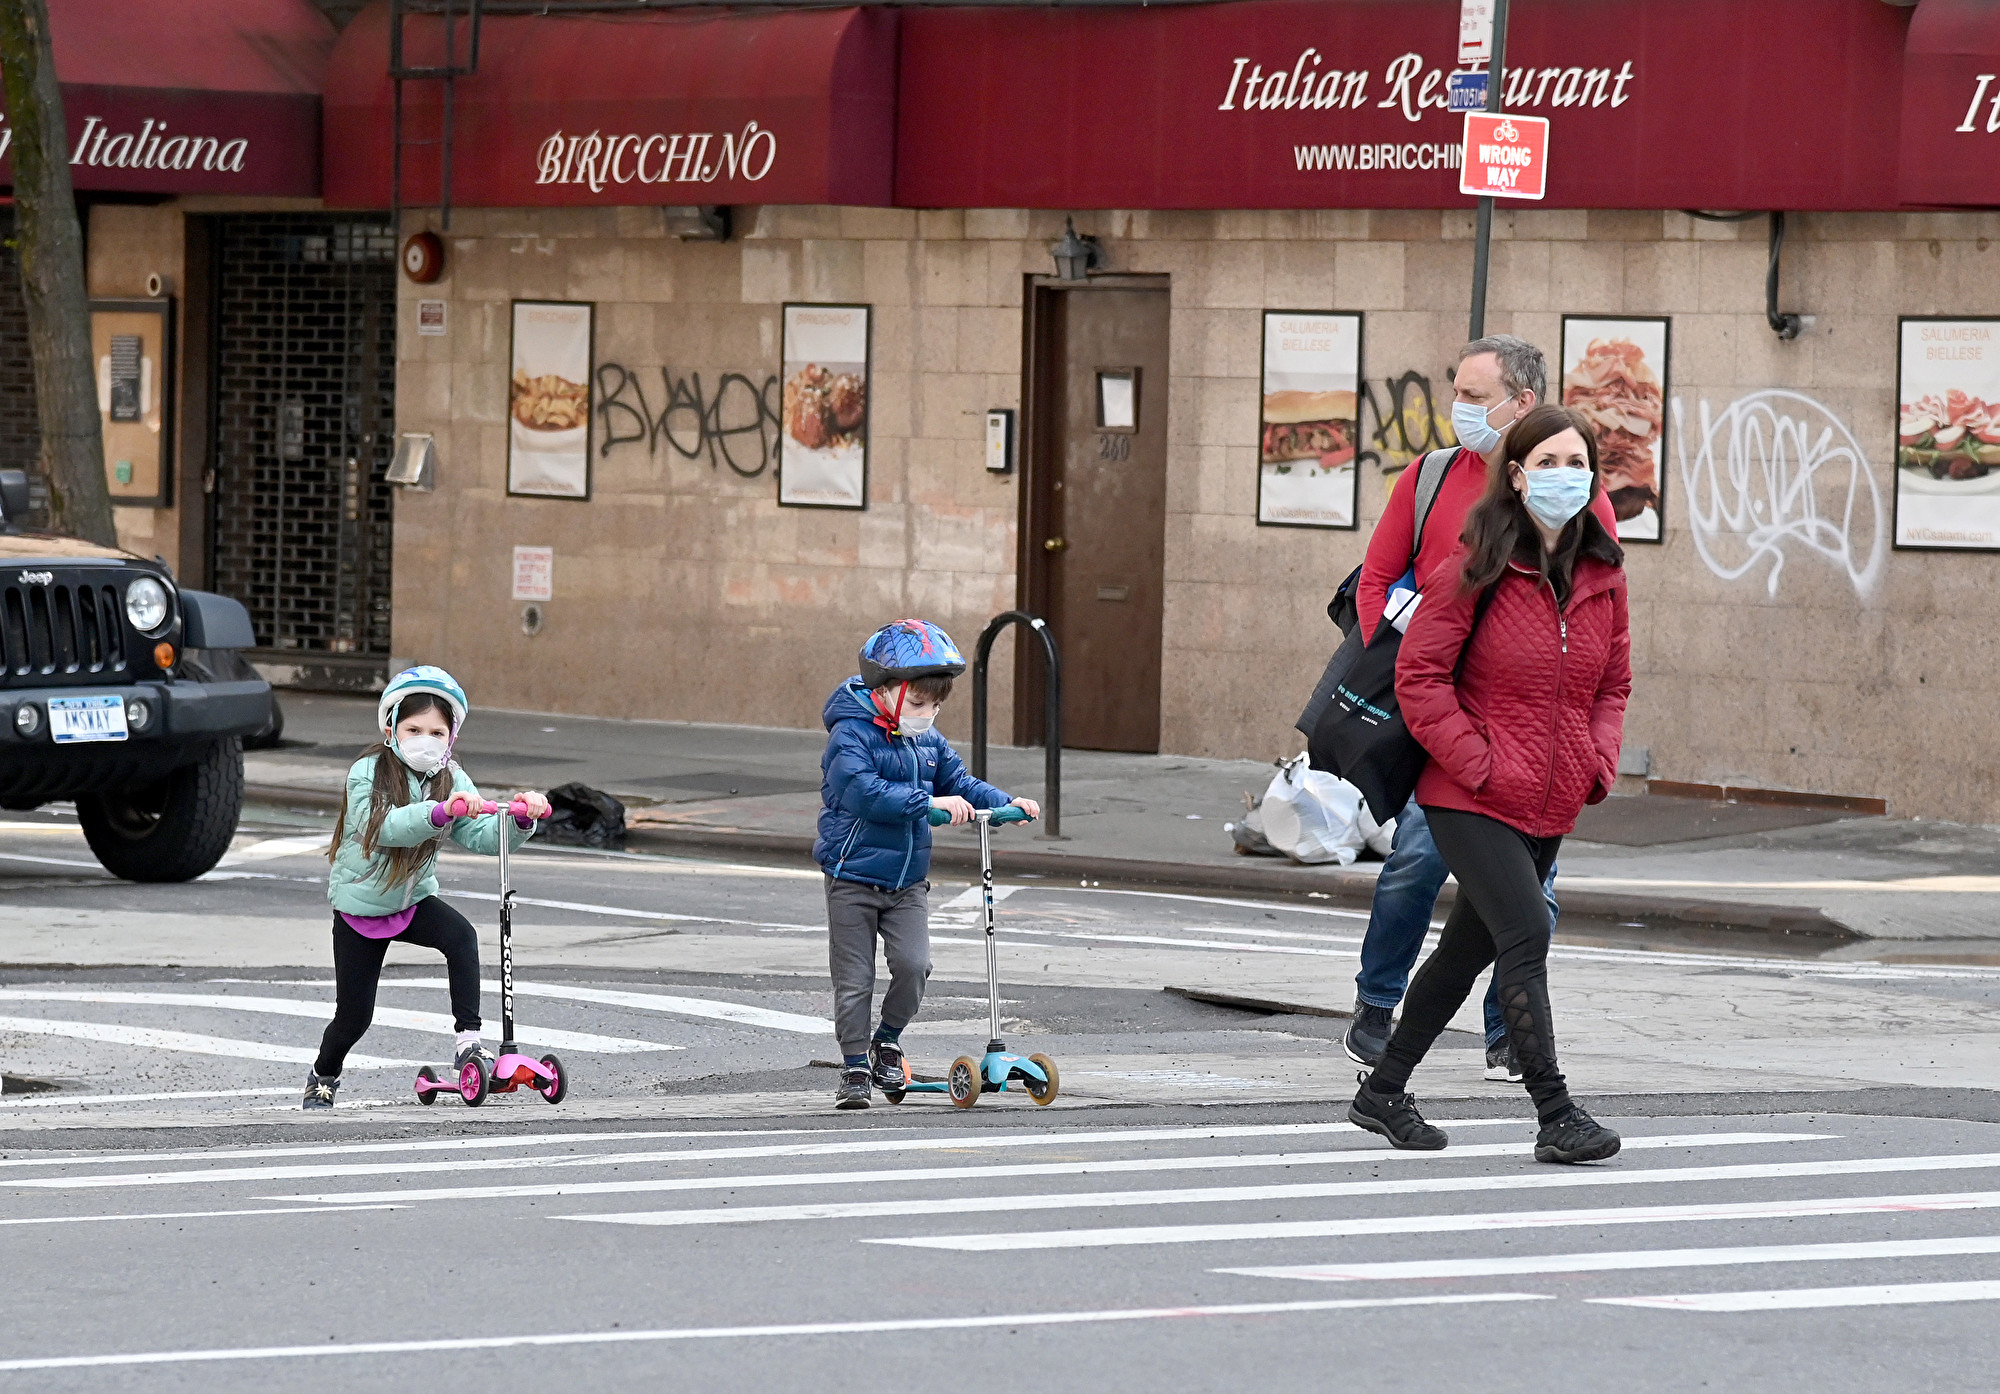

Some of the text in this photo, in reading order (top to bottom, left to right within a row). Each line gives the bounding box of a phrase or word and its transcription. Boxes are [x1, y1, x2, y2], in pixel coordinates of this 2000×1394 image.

[1218, 48, 1369, 111] Italian
[69, 115, 249, 173] Italiana
[535, 119, 777, 193] BIRICCHINO
[1478, 143, 1532, 168] WRONG
[1486, 165, 1521, 188] WAY
[1279, 320, 1340, 335] SALUMERIA
[1920, 327, 1991, 342] SALUMERIA
[1281, 338, 1333, 352] BIELLESE
[1926, 346, 1984, 361] BIELLESE
[1906, 527, 1993, 543] NYCsalami.com
[18, 569, 53, 586] Jeep
[1344, 690, 1359, 703] and
[1357, 698, 1392, 720] Company
